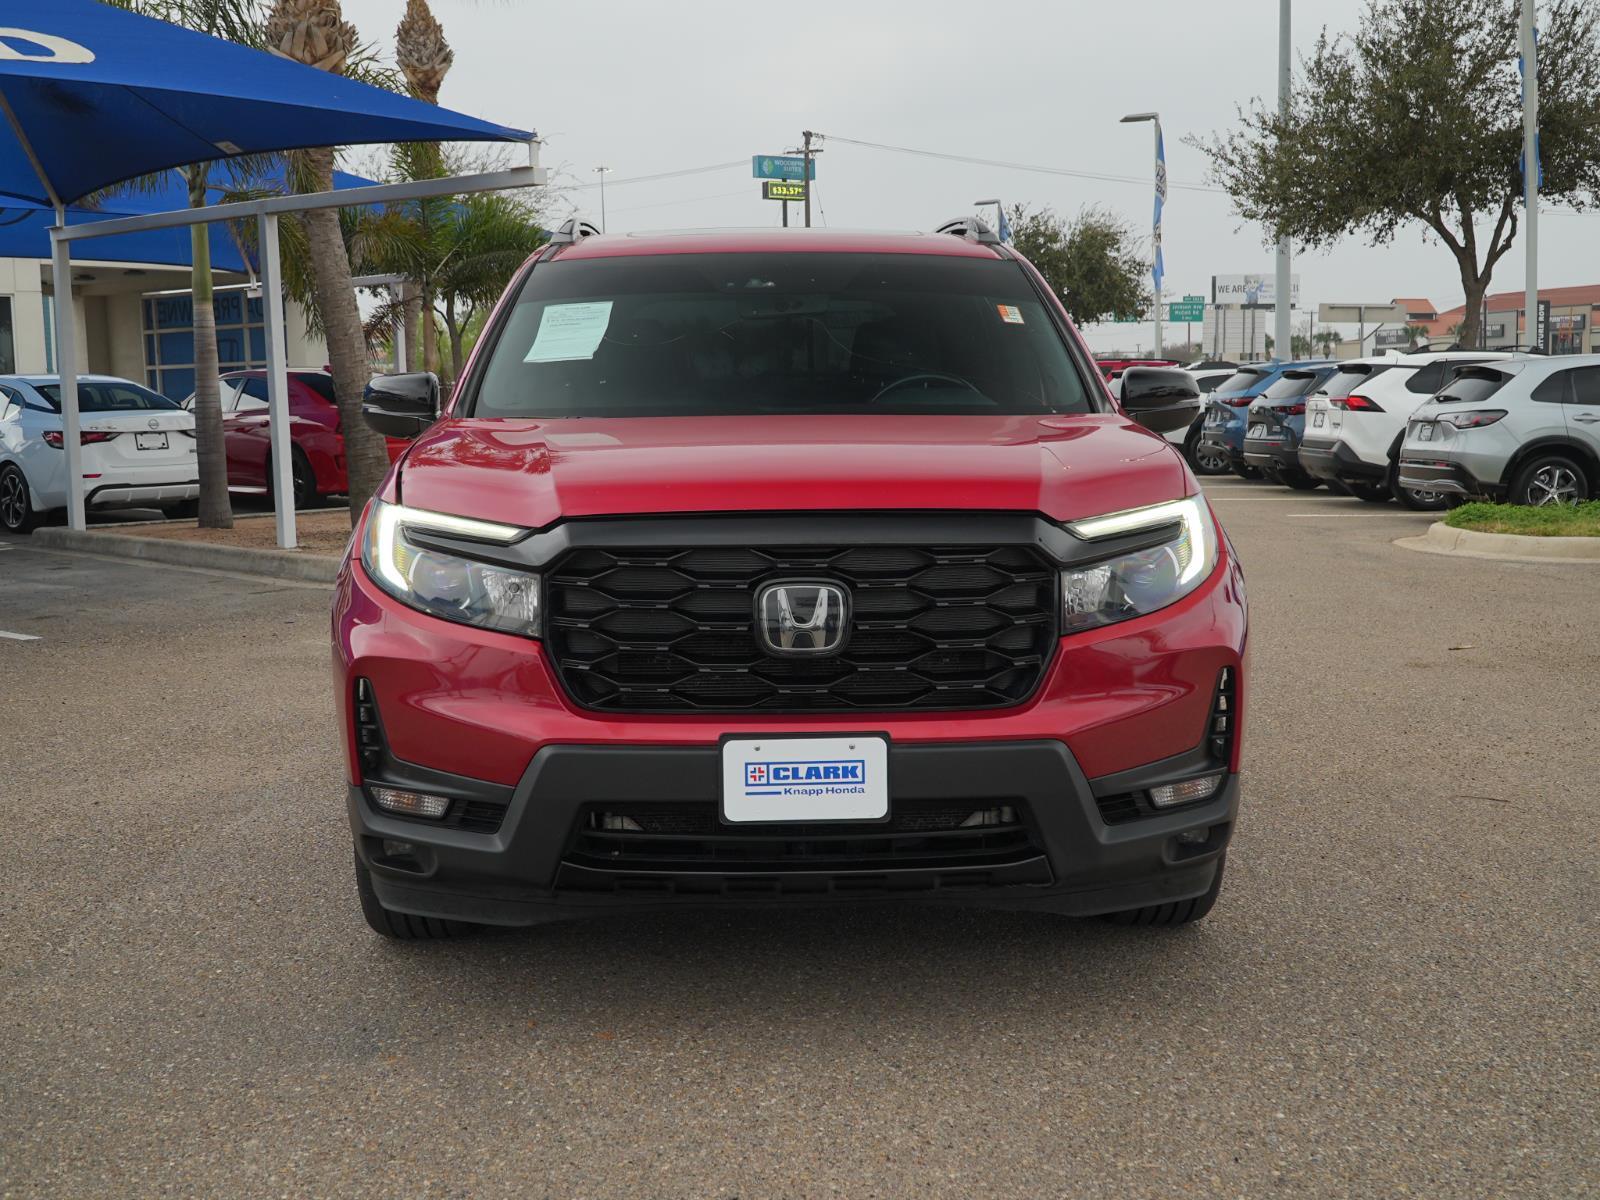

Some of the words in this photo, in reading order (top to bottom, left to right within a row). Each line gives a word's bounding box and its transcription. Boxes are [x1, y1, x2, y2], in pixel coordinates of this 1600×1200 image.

[1217, 285, 1230, 293] WE
[1232, 285, 1246, 293] ARE
[773, 765, 859, 780] CLARK
[784, 787, 823, 796] Knapp
[825, 786, 865, 794] Honda
